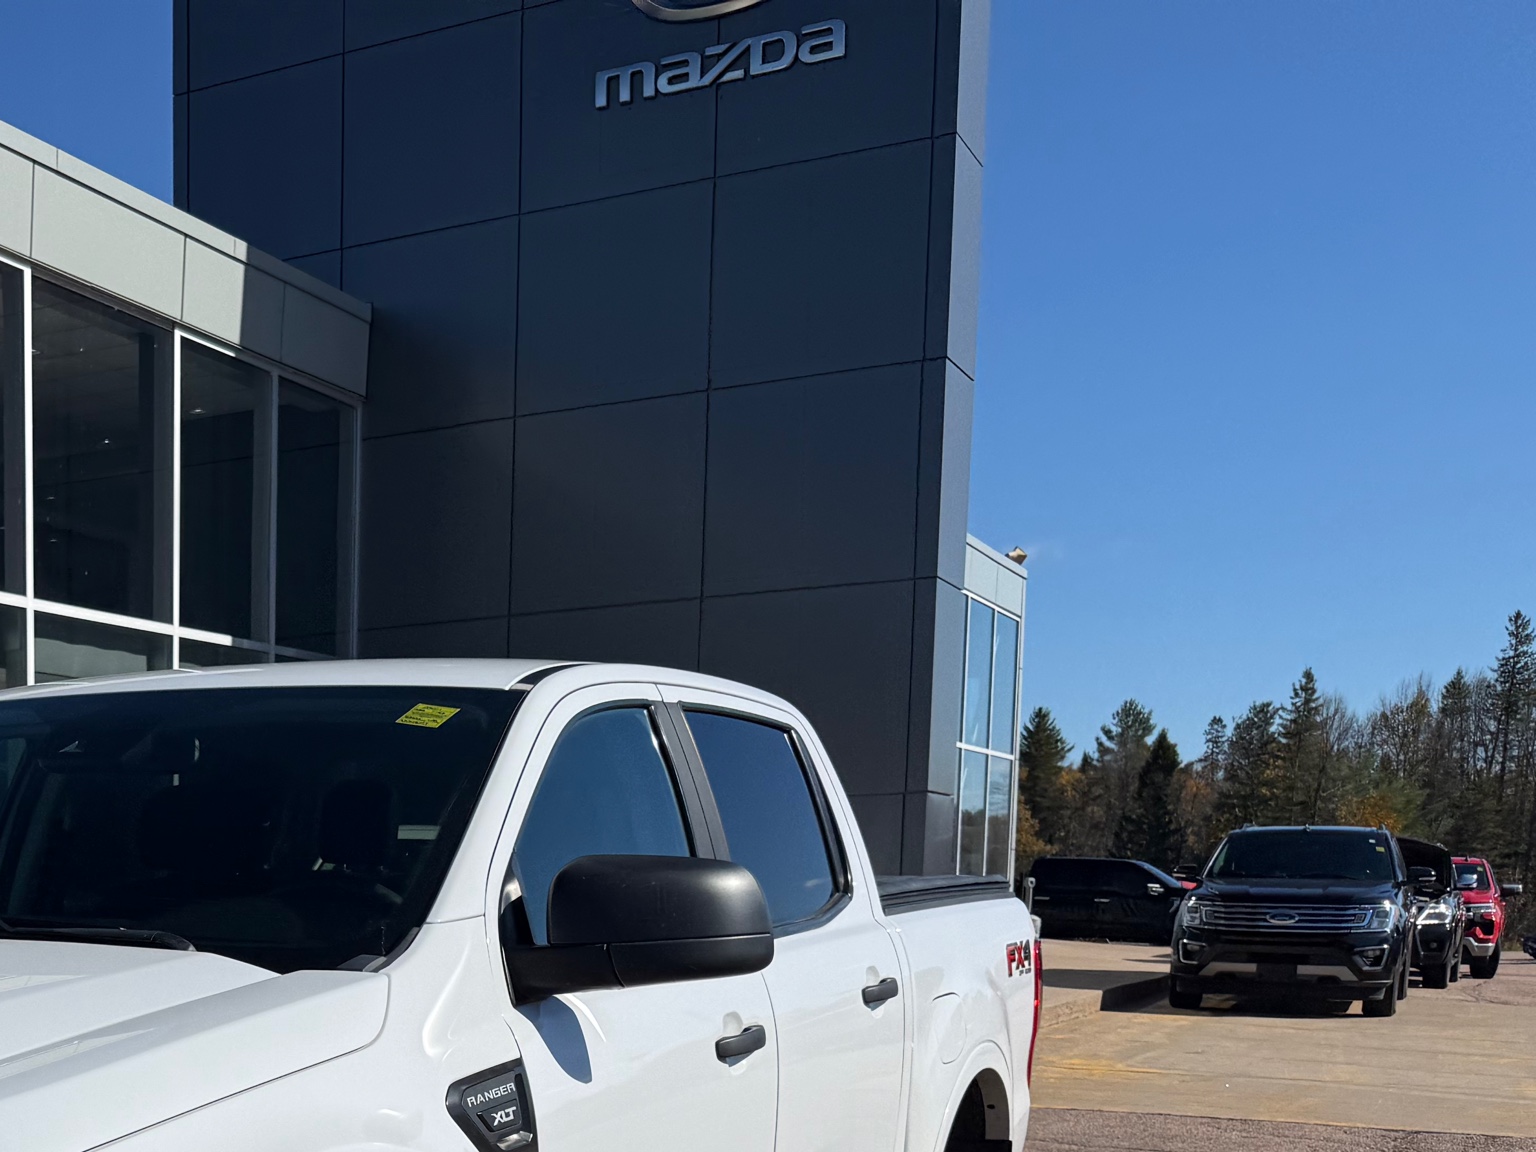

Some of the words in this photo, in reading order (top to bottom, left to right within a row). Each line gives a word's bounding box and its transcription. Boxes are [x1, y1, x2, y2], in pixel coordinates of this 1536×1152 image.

[1006, 939, 1031, 978] FX4
[466, 1082, 516, 1107] RANGER
[491, 1106, 517, 1126] XLT
